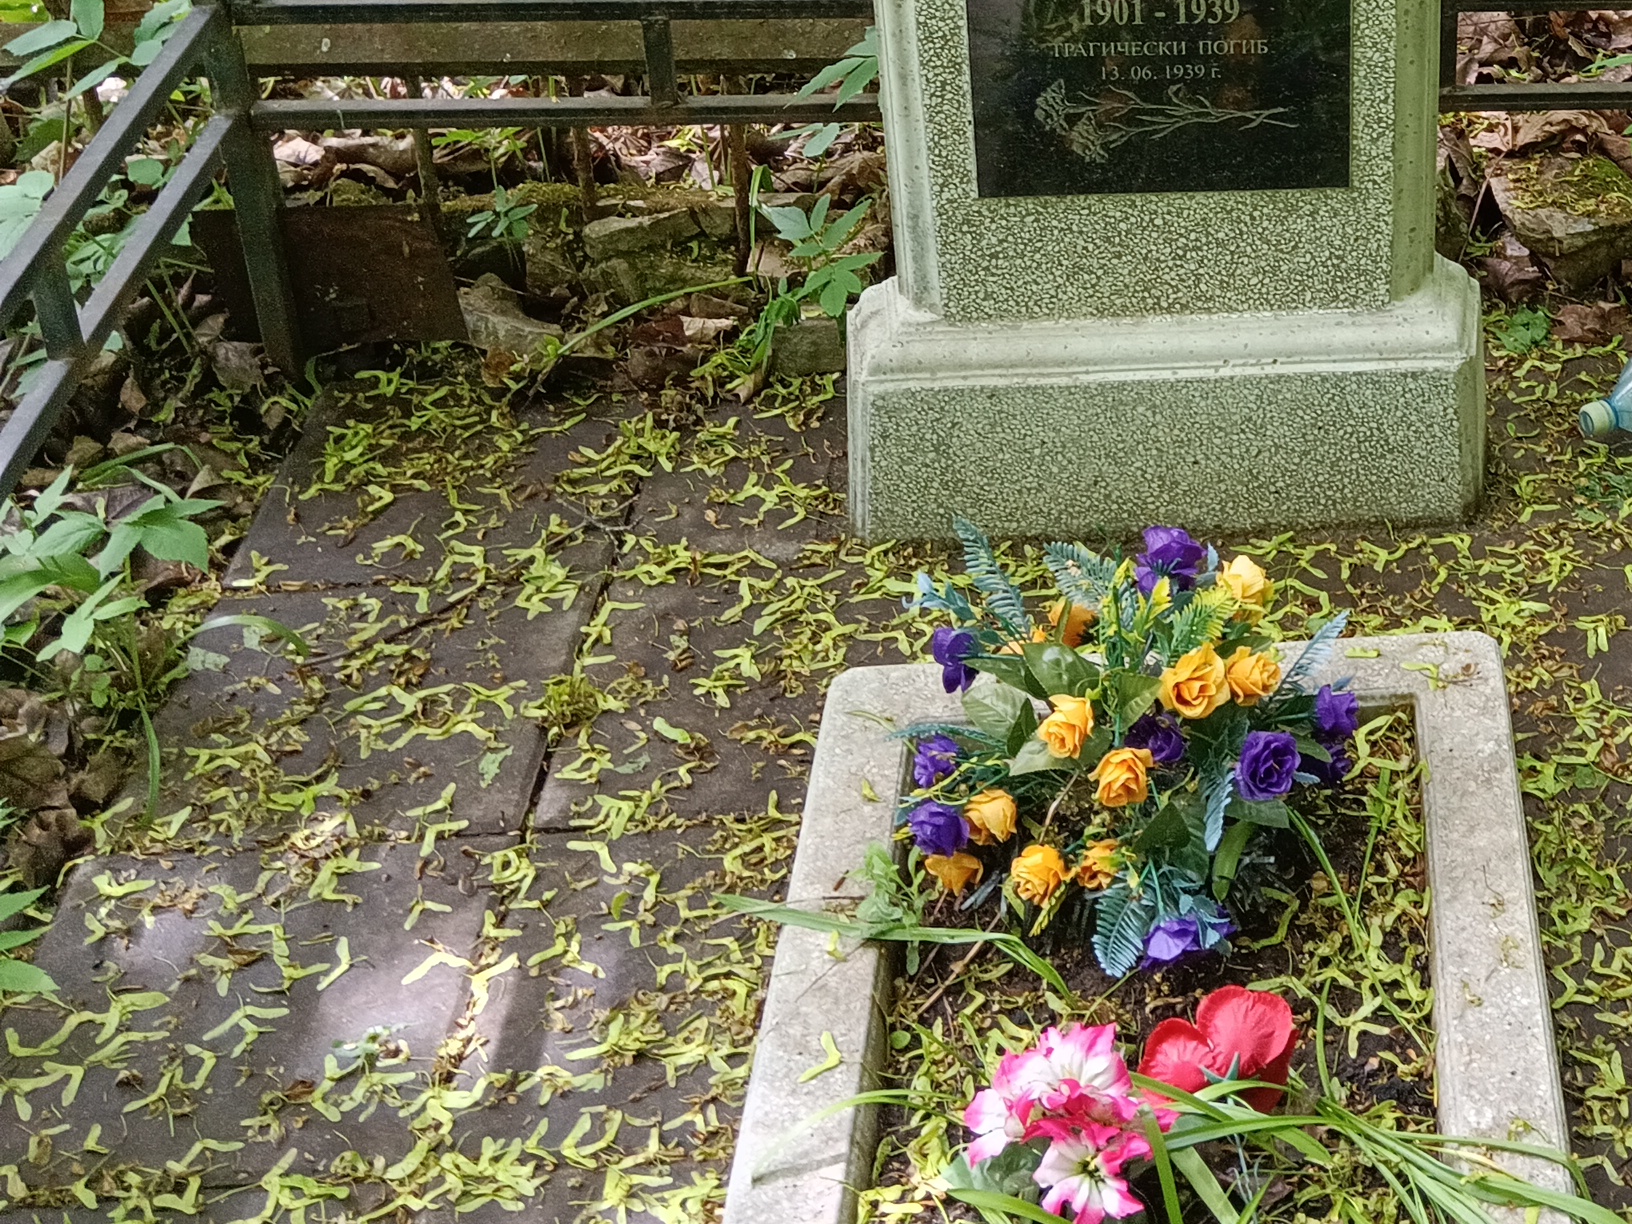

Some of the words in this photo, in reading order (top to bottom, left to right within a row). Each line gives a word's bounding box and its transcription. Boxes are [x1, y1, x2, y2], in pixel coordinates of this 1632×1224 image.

[1053, 40, 1187, 58] ТРАГИЧЕСКИ
[1199, 38, 1269, 56] ПОГИБ
[1166, 64, 1206, 80] 1939
